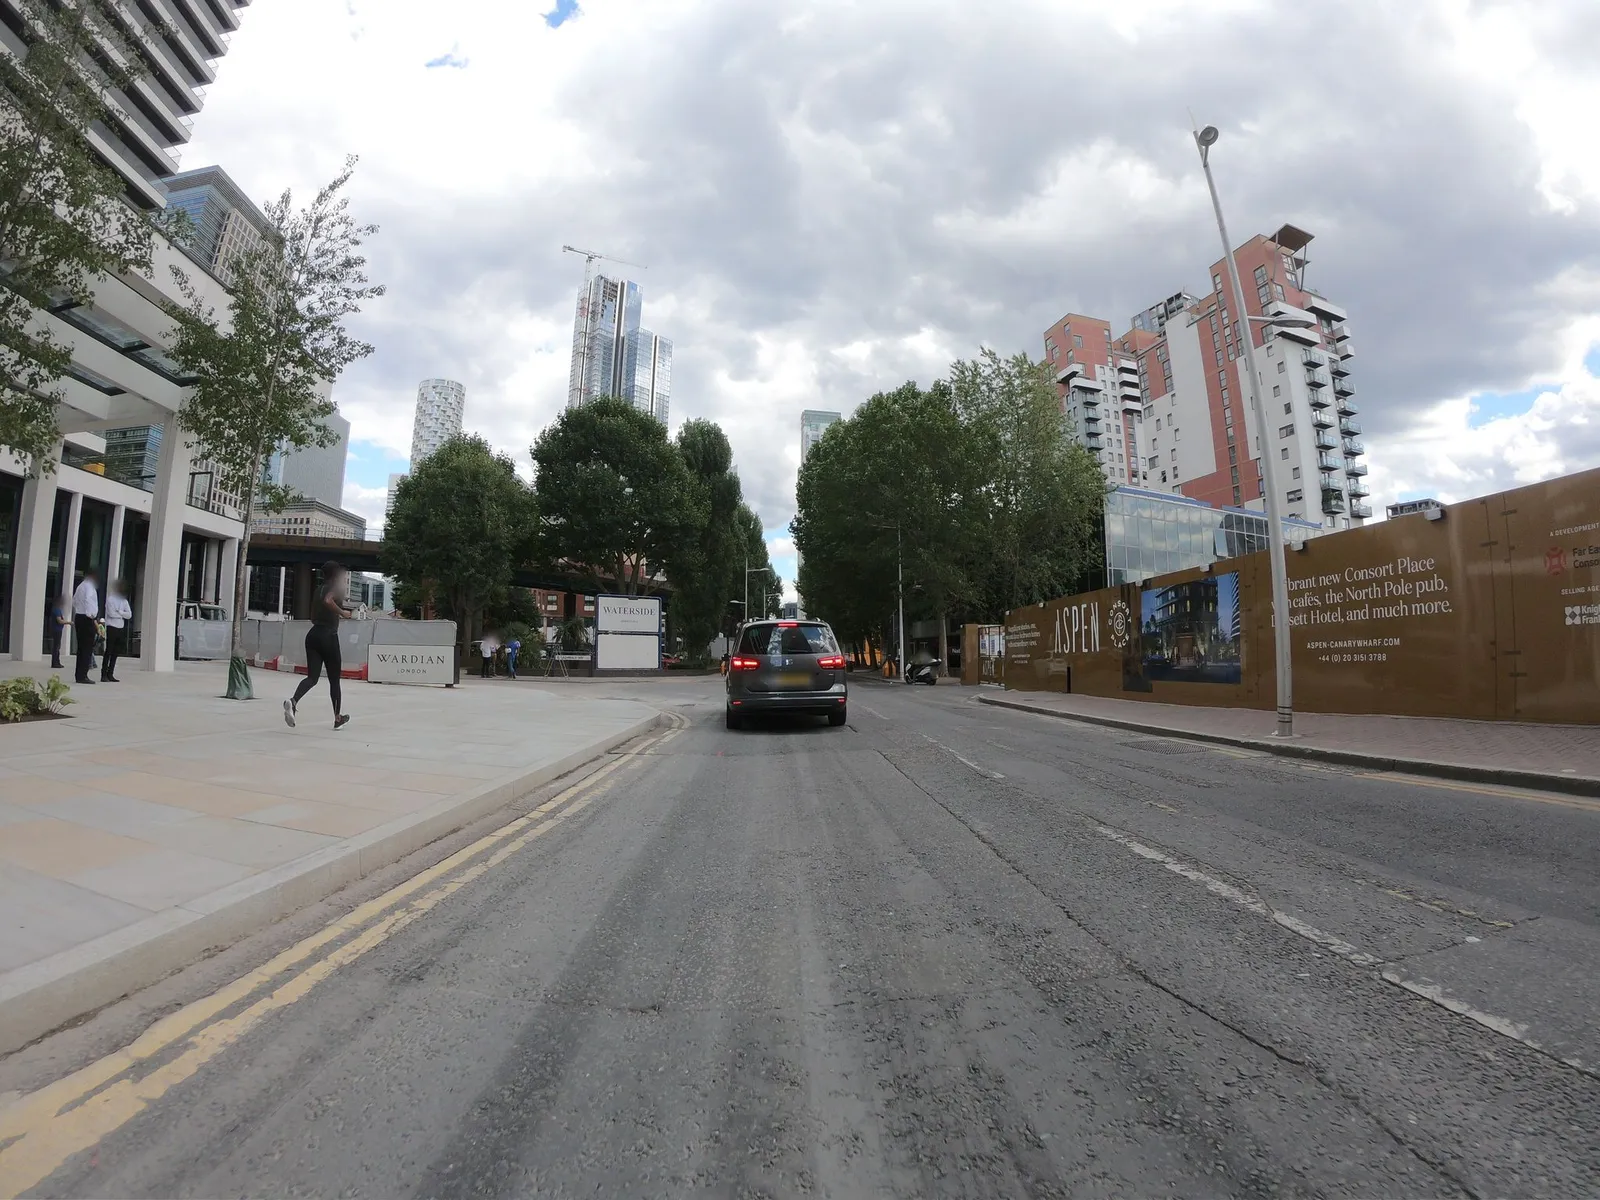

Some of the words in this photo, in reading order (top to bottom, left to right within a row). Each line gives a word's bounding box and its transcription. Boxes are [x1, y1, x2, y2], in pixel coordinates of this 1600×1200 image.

[1555, 522, 1600, 536] DEVELOPMENT
[1573, 548, 1587, 557] Far
[1319, 571, 1342, 586] new
[1344, 561, 1395, 582] Consort
[1397, 555, 1436, 575] Place
[1292, 591, 1322, 608] cafés,
[1325, 588, 1344, 604] the
[1345, 581, 1382, 602] North
[1384, 578, 1413, 598] Pole
[1415, 574, 1449, 597] pub,
[1561, 587, 1585, 595] SELLING
[603, 606, 656, 616] WATERSIDE
[1108, 599, 1132, 626] CONSORT
[1310, 606, 1345, 625] Hotel,
[1346, 603, 1369, 622] and
[1372, 600, 1409, 618] much
[1411, 600, 1452, 614] more.
[1054, 601, 1100, 654] ASPEN
[1110, 629, 1130, 649] PLACE
[376, 654, 445, 665] WARDIAN
[1331, 653, 1341, 664] (0)
[1343, 654, 1352, 662] 20
[1353, 653, 1367, 662] 3151
[1369, 653, 1387, 662] 3788
